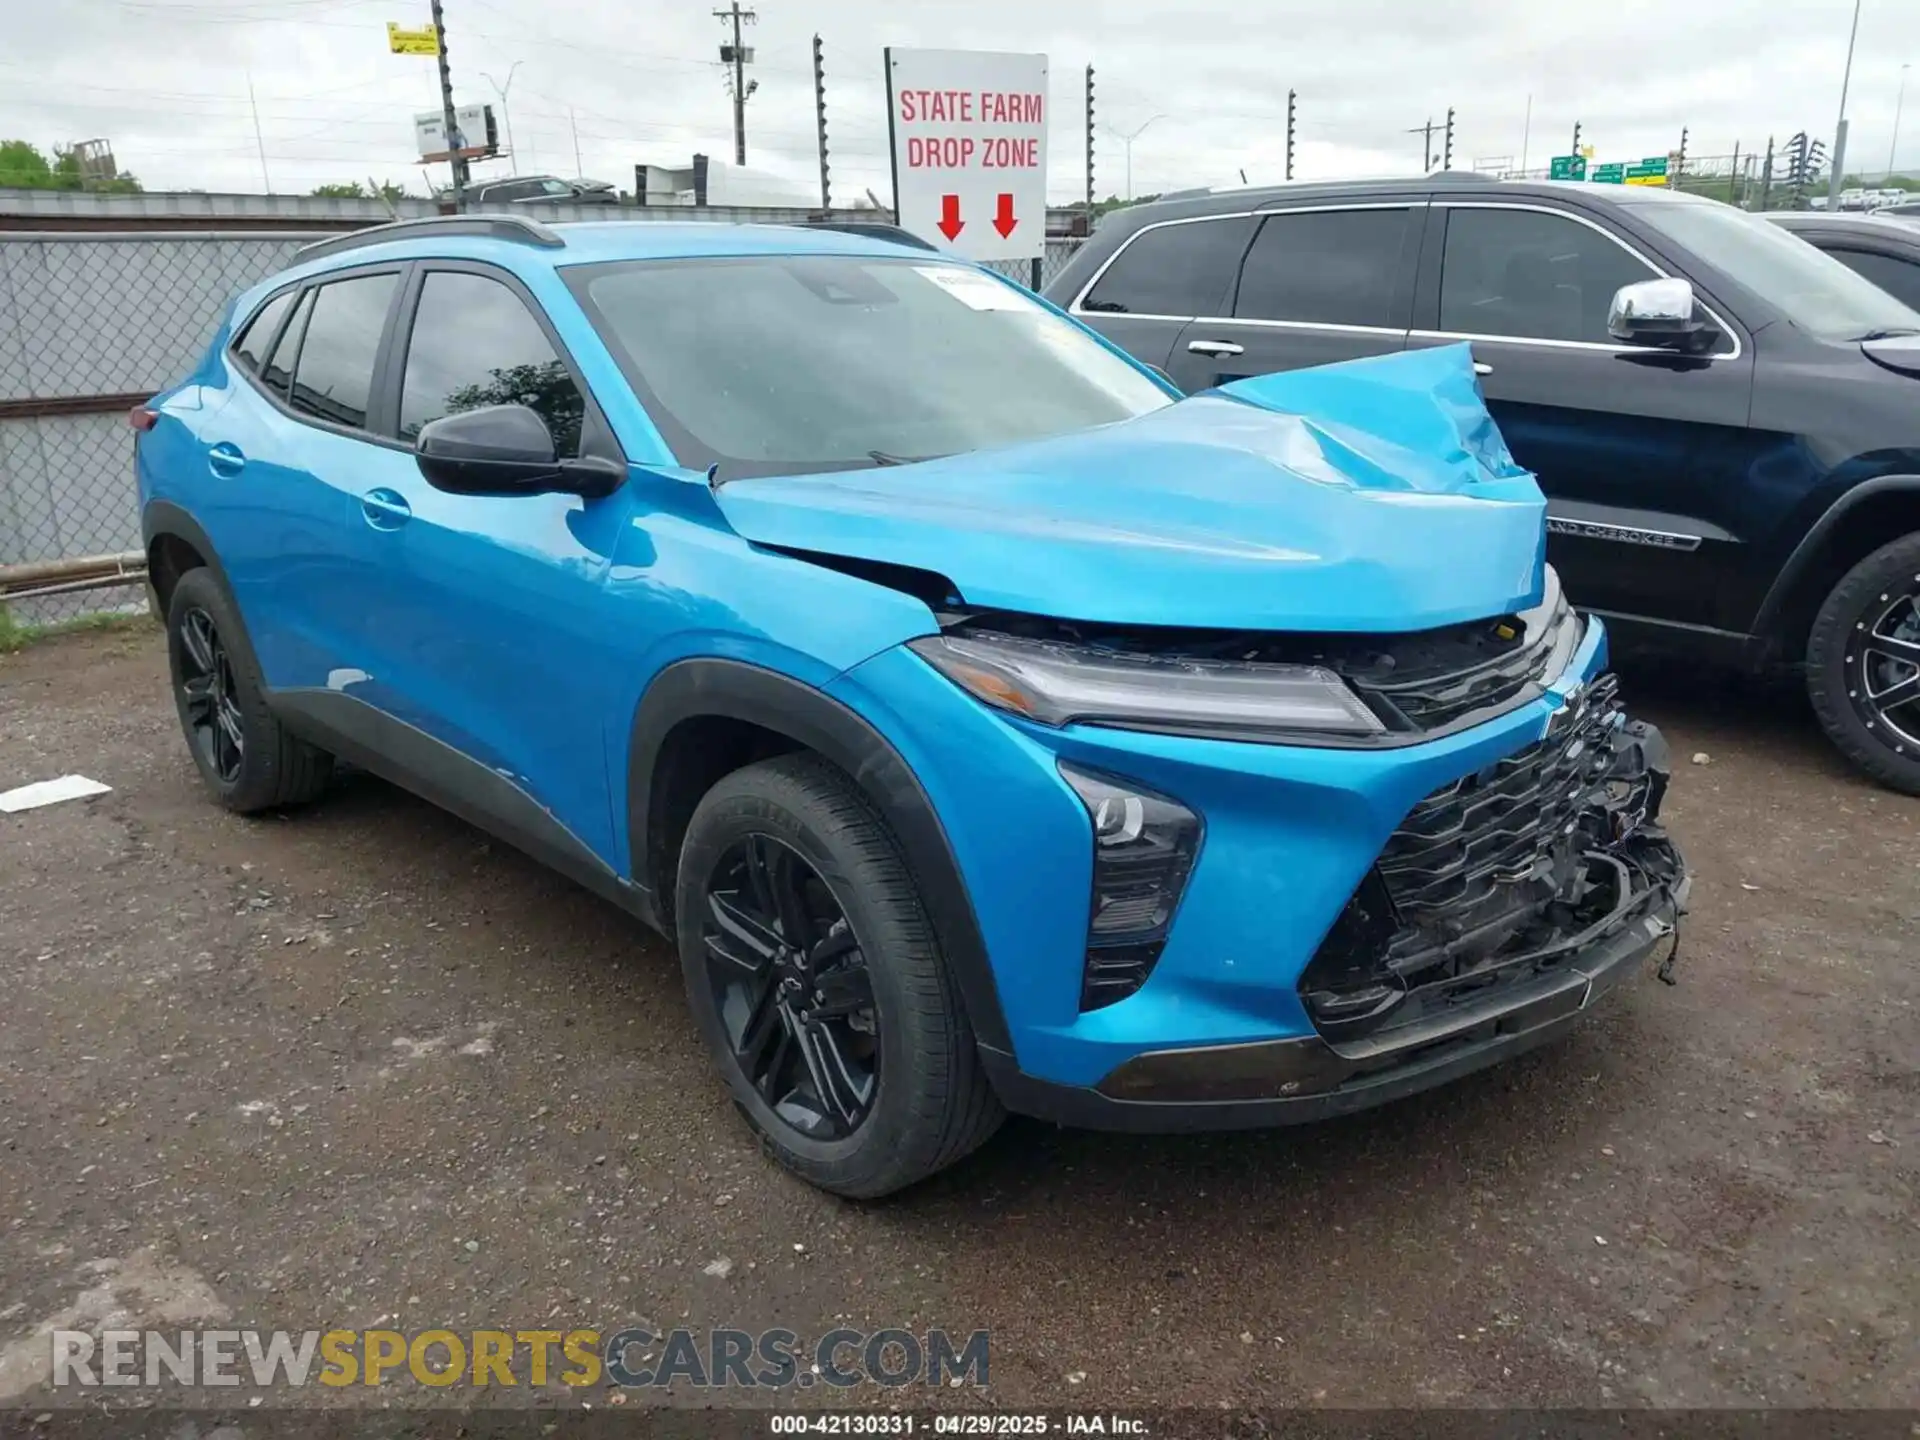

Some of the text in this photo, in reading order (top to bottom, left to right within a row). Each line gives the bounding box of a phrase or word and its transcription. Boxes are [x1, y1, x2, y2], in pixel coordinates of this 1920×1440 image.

[900, 90, 1042, 123] STATE FARM
[908, 137, 1038, 168] DROP ZONE
[1585, 525, 1675, 546] CHEROKEE
